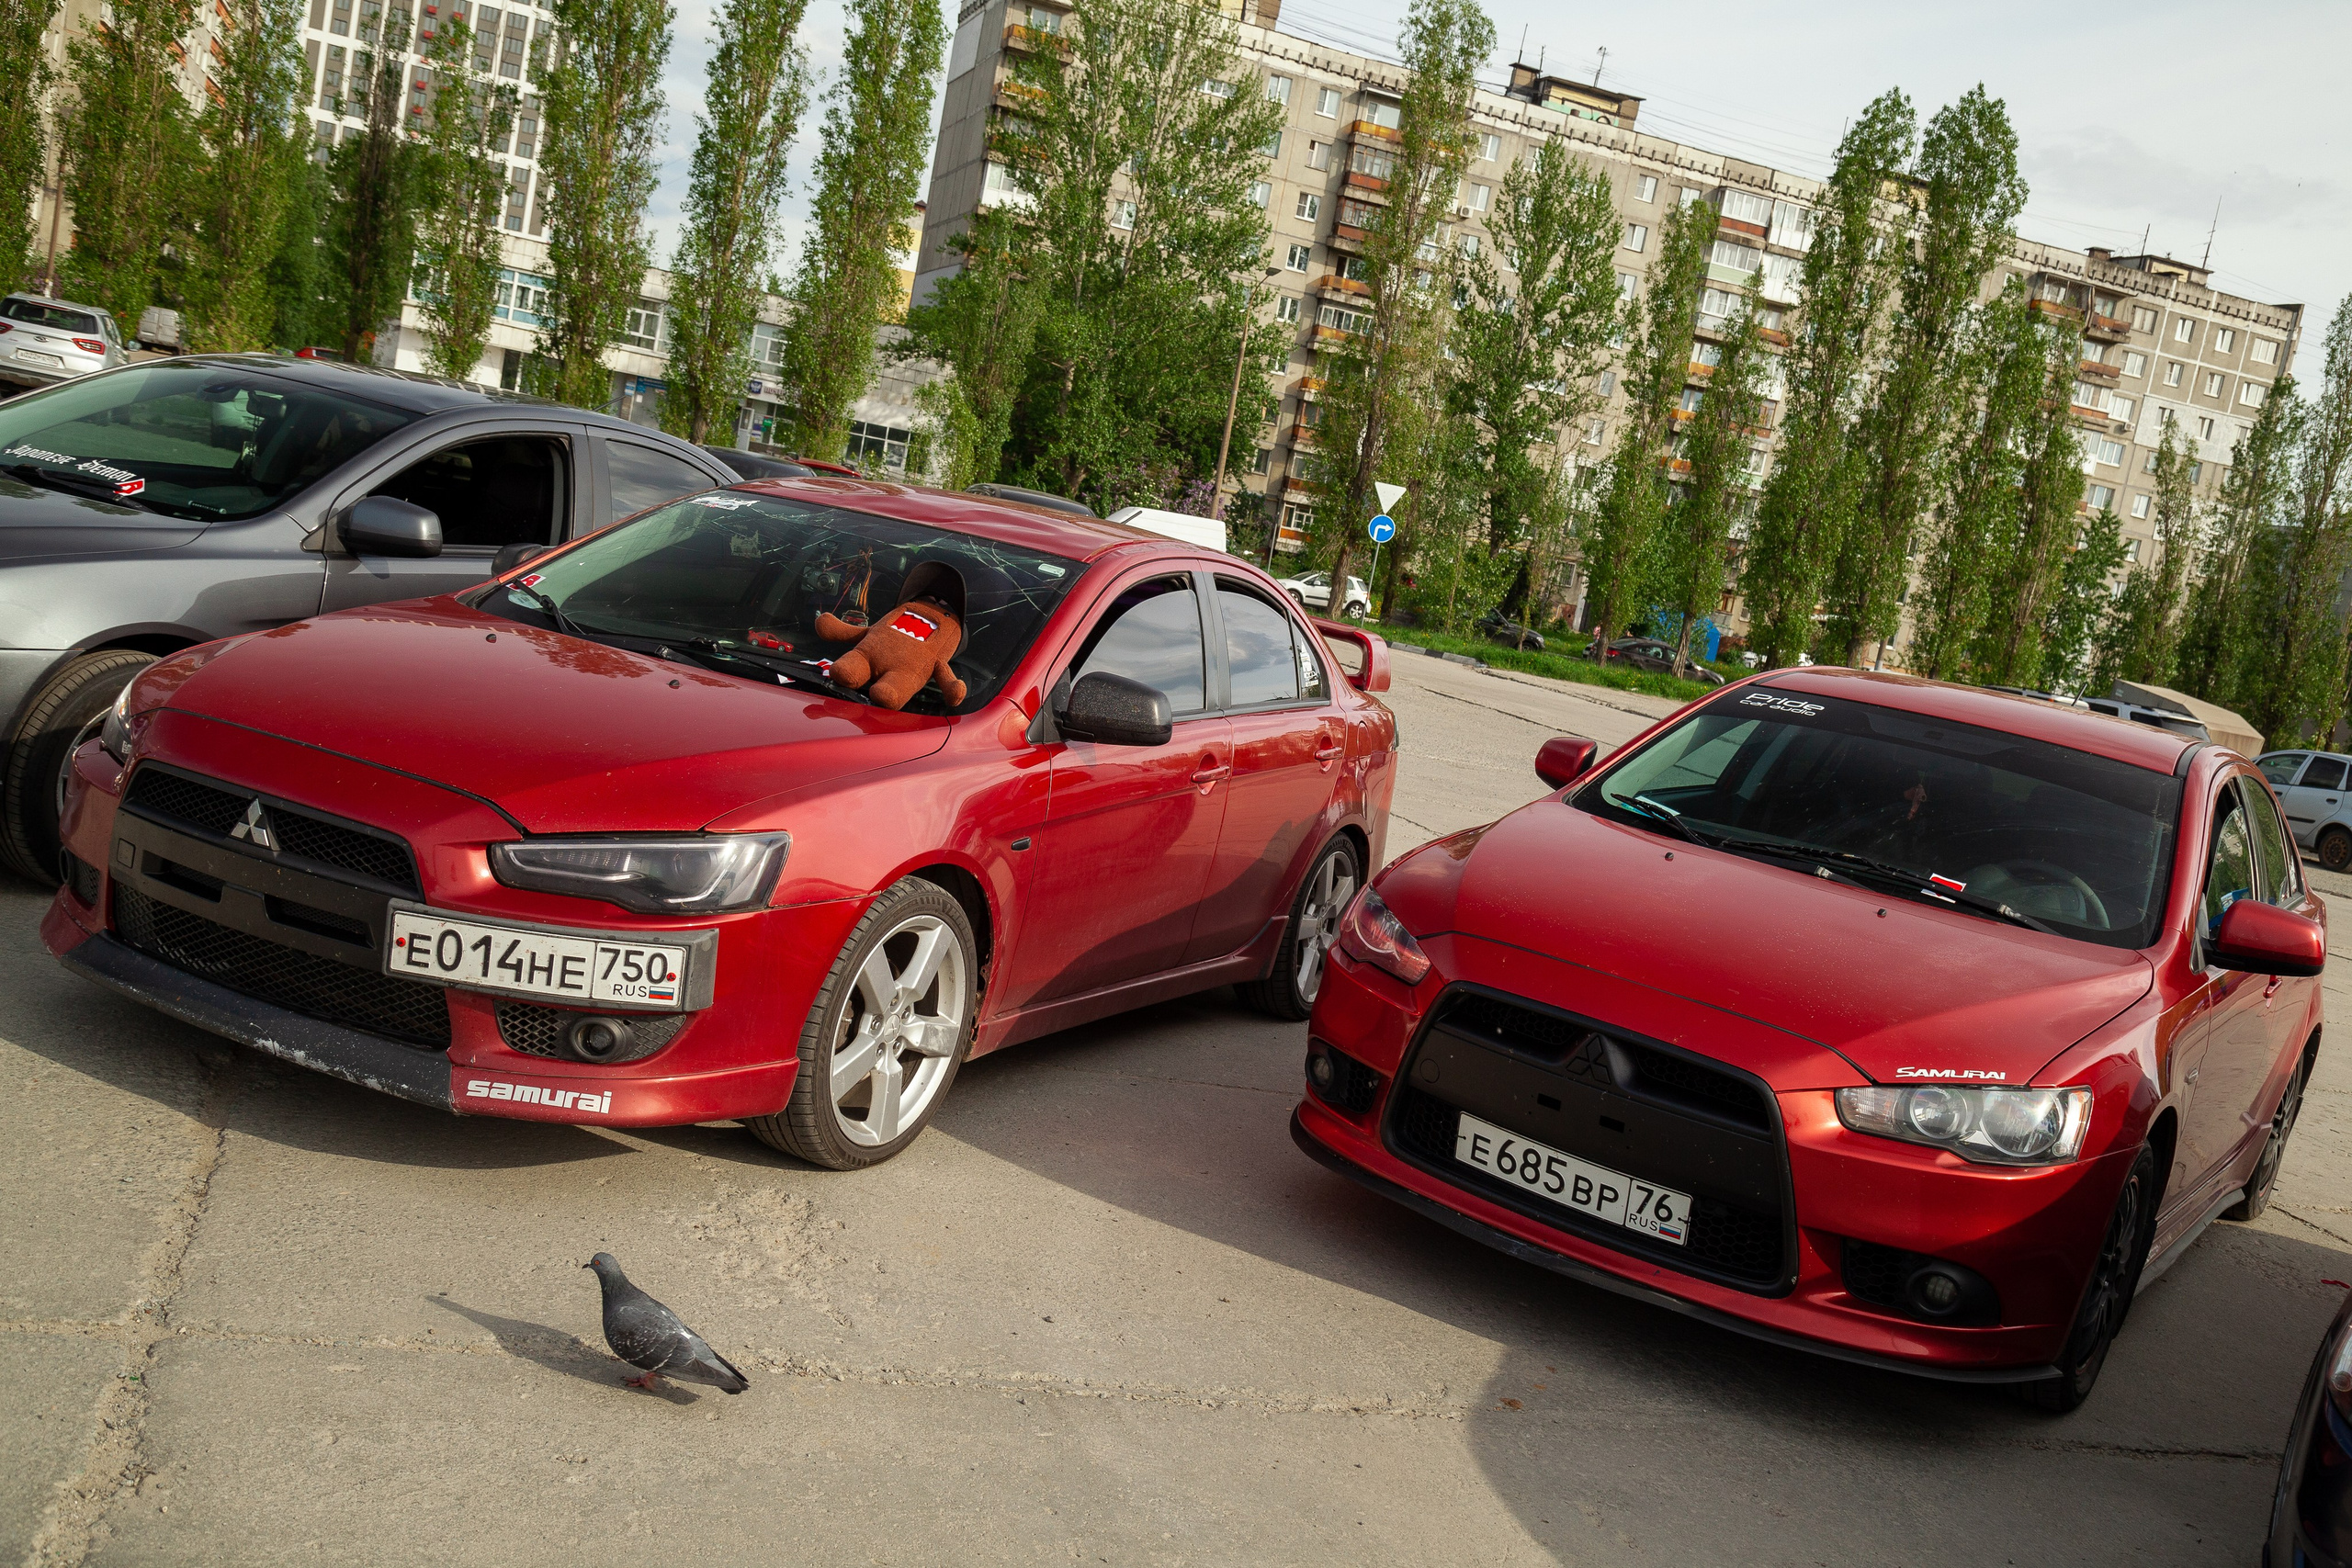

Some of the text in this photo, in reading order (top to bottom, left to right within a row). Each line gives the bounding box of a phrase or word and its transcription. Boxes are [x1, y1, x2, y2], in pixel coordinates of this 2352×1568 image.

[4, 444, 137, 482] Japanese Demon
[1739, 699, 1816, 716] car audio
[1746, 693, 1825, 711] Pride
[406, 929, 669, 990] E014HE 750
[612, 984, 648, 998] RUS
[1895, 1066, 2006, 1080] SAMURAI
[466, 1079, 613, 1114] samurai
[1470, 1133, 1674, 1223] E685BP 76
[1628, 1213, 1658, 1232] RUS
